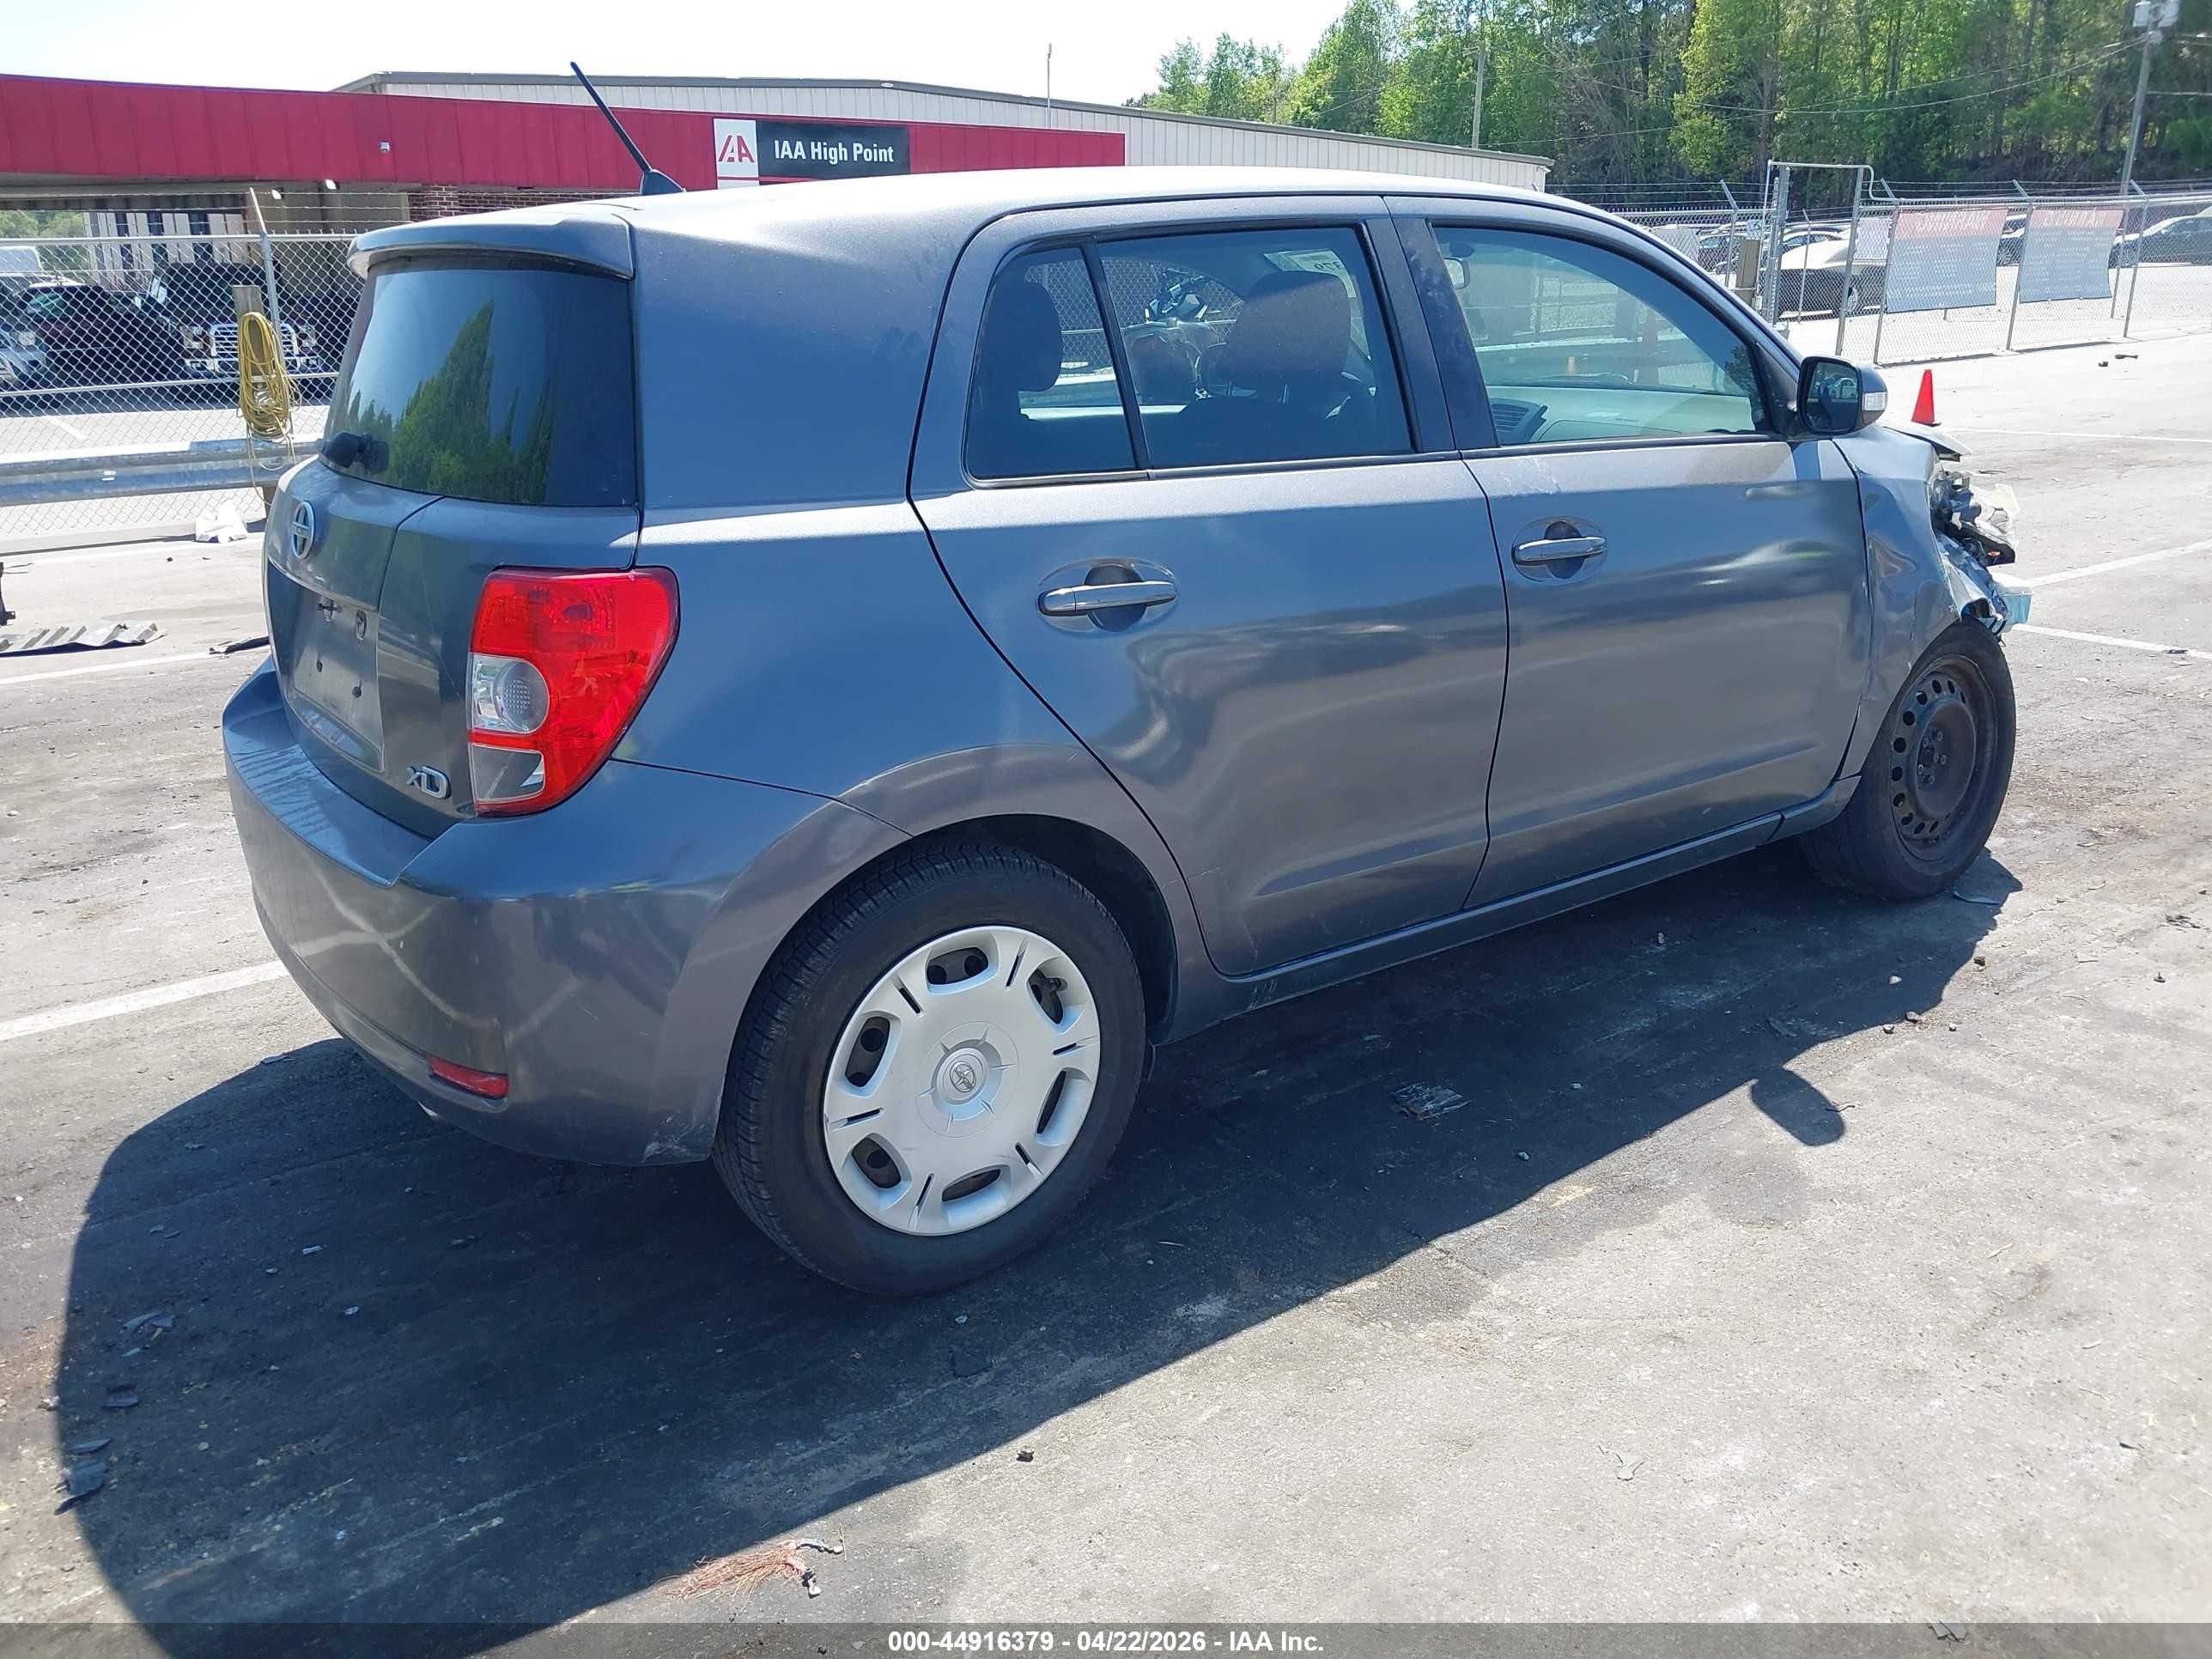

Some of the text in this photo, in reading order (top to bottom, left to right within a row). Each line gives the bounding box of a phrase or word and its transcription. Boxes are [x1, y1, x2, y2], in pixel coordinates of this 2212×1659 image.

[775, 140, 894, 165] IAA High Point
